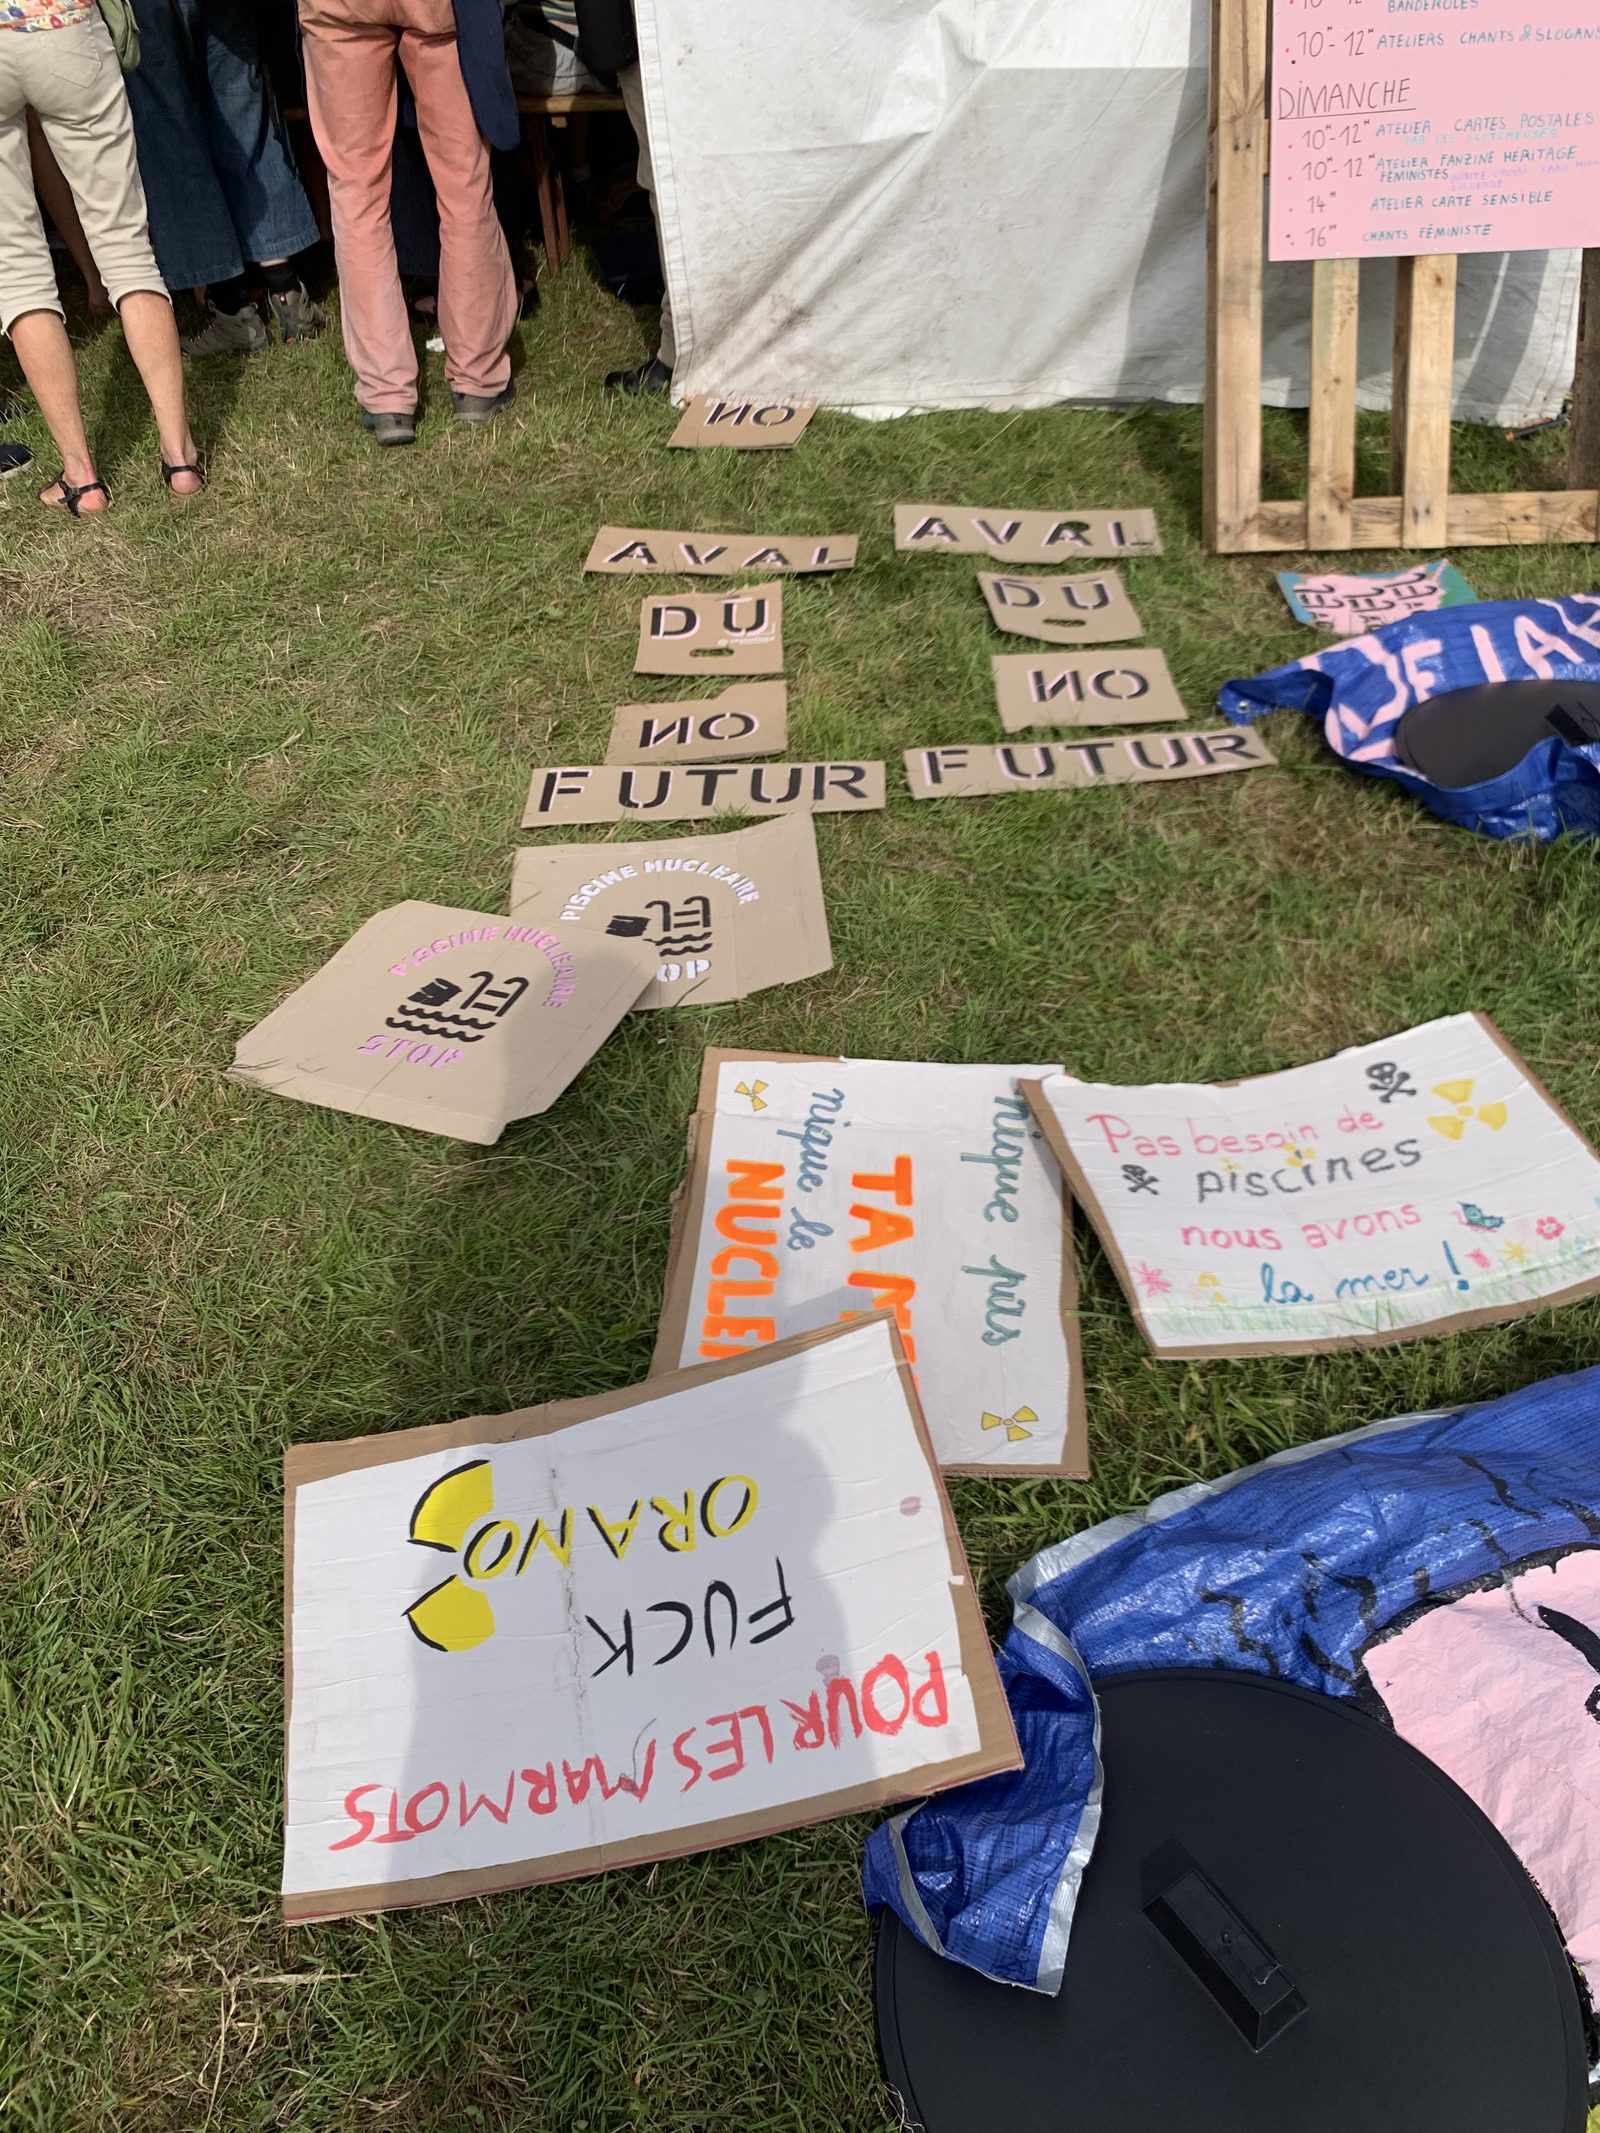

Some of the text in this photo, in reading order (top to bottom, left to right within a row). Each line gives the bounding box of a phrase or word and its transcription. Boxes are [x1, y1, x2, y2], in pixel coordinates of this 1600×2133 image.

[1377, 32, 1444, 49] ATELIERS
[1459, 30, 1514, 44] CHANTS
[1376, 120, 1431, 137] ATELIER
[1454, 116, 1506, 132] CARTES
[1520, 112, 1594, 129] POSTALES
[1376, 157, 1428, 171] ATELIER
[1440, 151, 1495, 166] FANZINE
[1370, 196, 1423, 211] ATELIER
[1432, 194, 1472, 208] CARTE
[1362, 229, 1408, 242] CHANTS
[602, 541, 854, 570] AVAL
[905, 517, 1154, 547] AVAL
[992, 579, 1111, 610] DU
[922, 734, 1257, 786] FUTUR
[536, 764, 869, 812] FUTUR
[559, 864, 639, 921] PISCINE
[387, 926, 498, 977] PISCINE
[656, 959, 712, 983] OP
[358, 1034, 465, 1069] STOP
[1085, 1105, 1384, 1158] Pas besoin de
[777, 1088, 852, 1251] nique le
[1197, 1136, 1422, 1203] piscines
[848, 1154, 915, 1254] TA
[1180, 1203, 1422, 1251] nous avons
[960, 1255, 1027, 1347] pas
[1259, 1262, 1314, 1304] la
[463, 1474, 760, 1580] ORANO
[585, 1556, 797, 1678] FUCK
[329, 1650, 949, 1851] POUR LES MARMOTS
